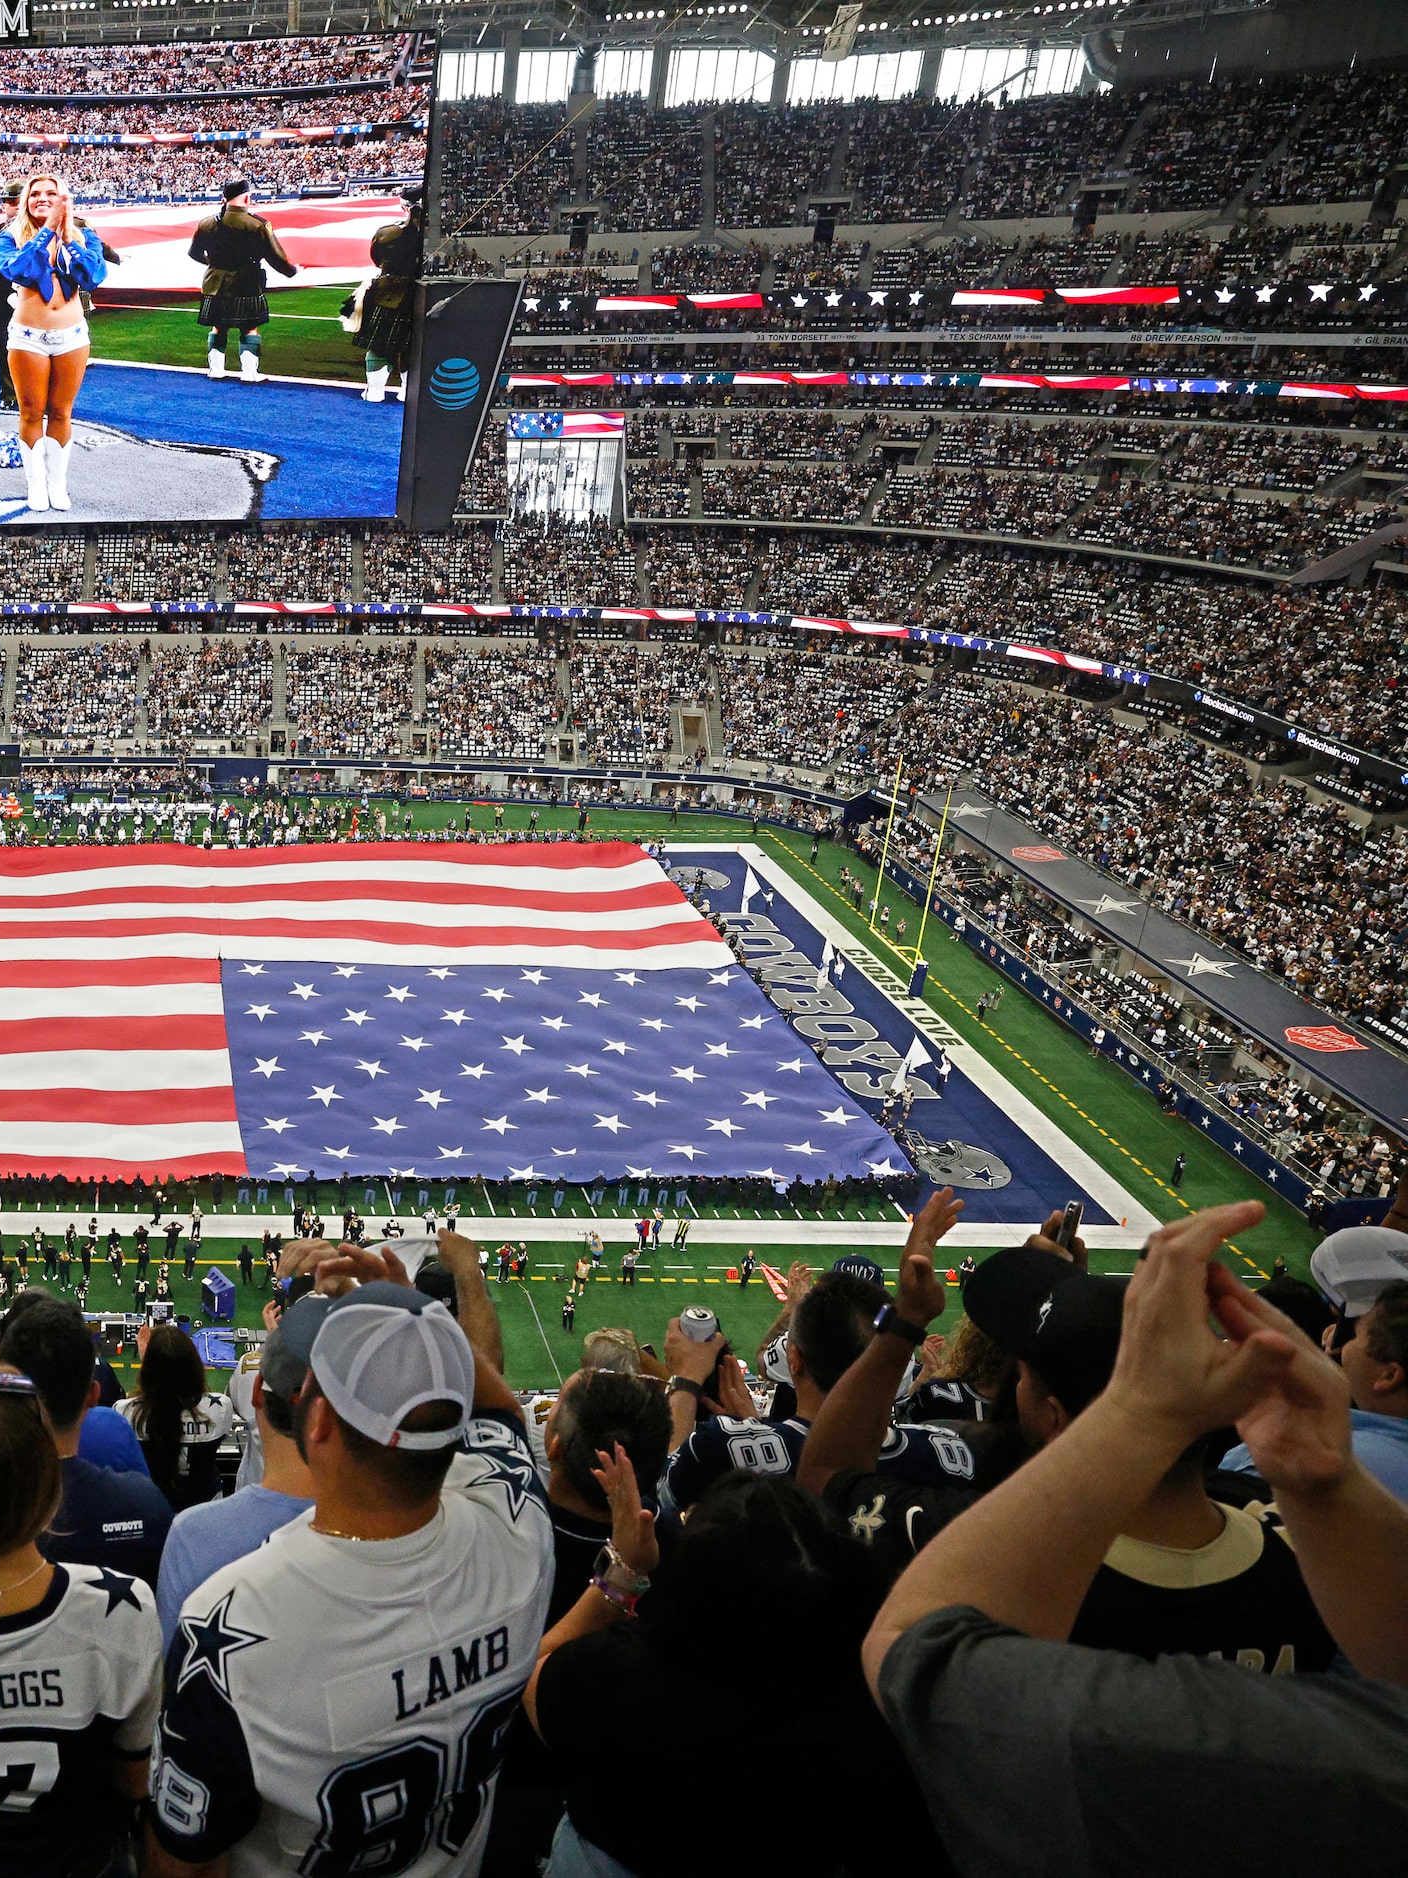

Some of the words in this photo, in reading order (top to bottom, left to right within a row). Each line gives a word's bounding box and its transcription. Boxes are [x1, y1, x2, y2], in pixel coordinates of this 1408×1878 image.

[600, 336, 616, 344] TOM
[618, 335, 648, 343] LANDRY
[791, 334, 829, 342] DORSETT
[948, 333, 967, 341] TEX
[968, 333, 1012, 341] SCHRAMM
[1130, 334, 1143, 342] 88
[1144, 334, 1173, 342] DREW
[1174, 334, 1221, 343] PEARSON
[1365, 336, 1380, 344] GIL
[1201, 694, 1255, 724] Blockchain.com
[1296, 731, 1360, 766] Blockchain.com
[844, 947, 917, 1002] CHOOSE
[902, 1006, 964, 1048] LOVE
[722, 912, 943, 1100] COWBOYS
[102, 1519, 144, 1534] COWBOYS
[392, 1625, 509, 1721] LAMB
